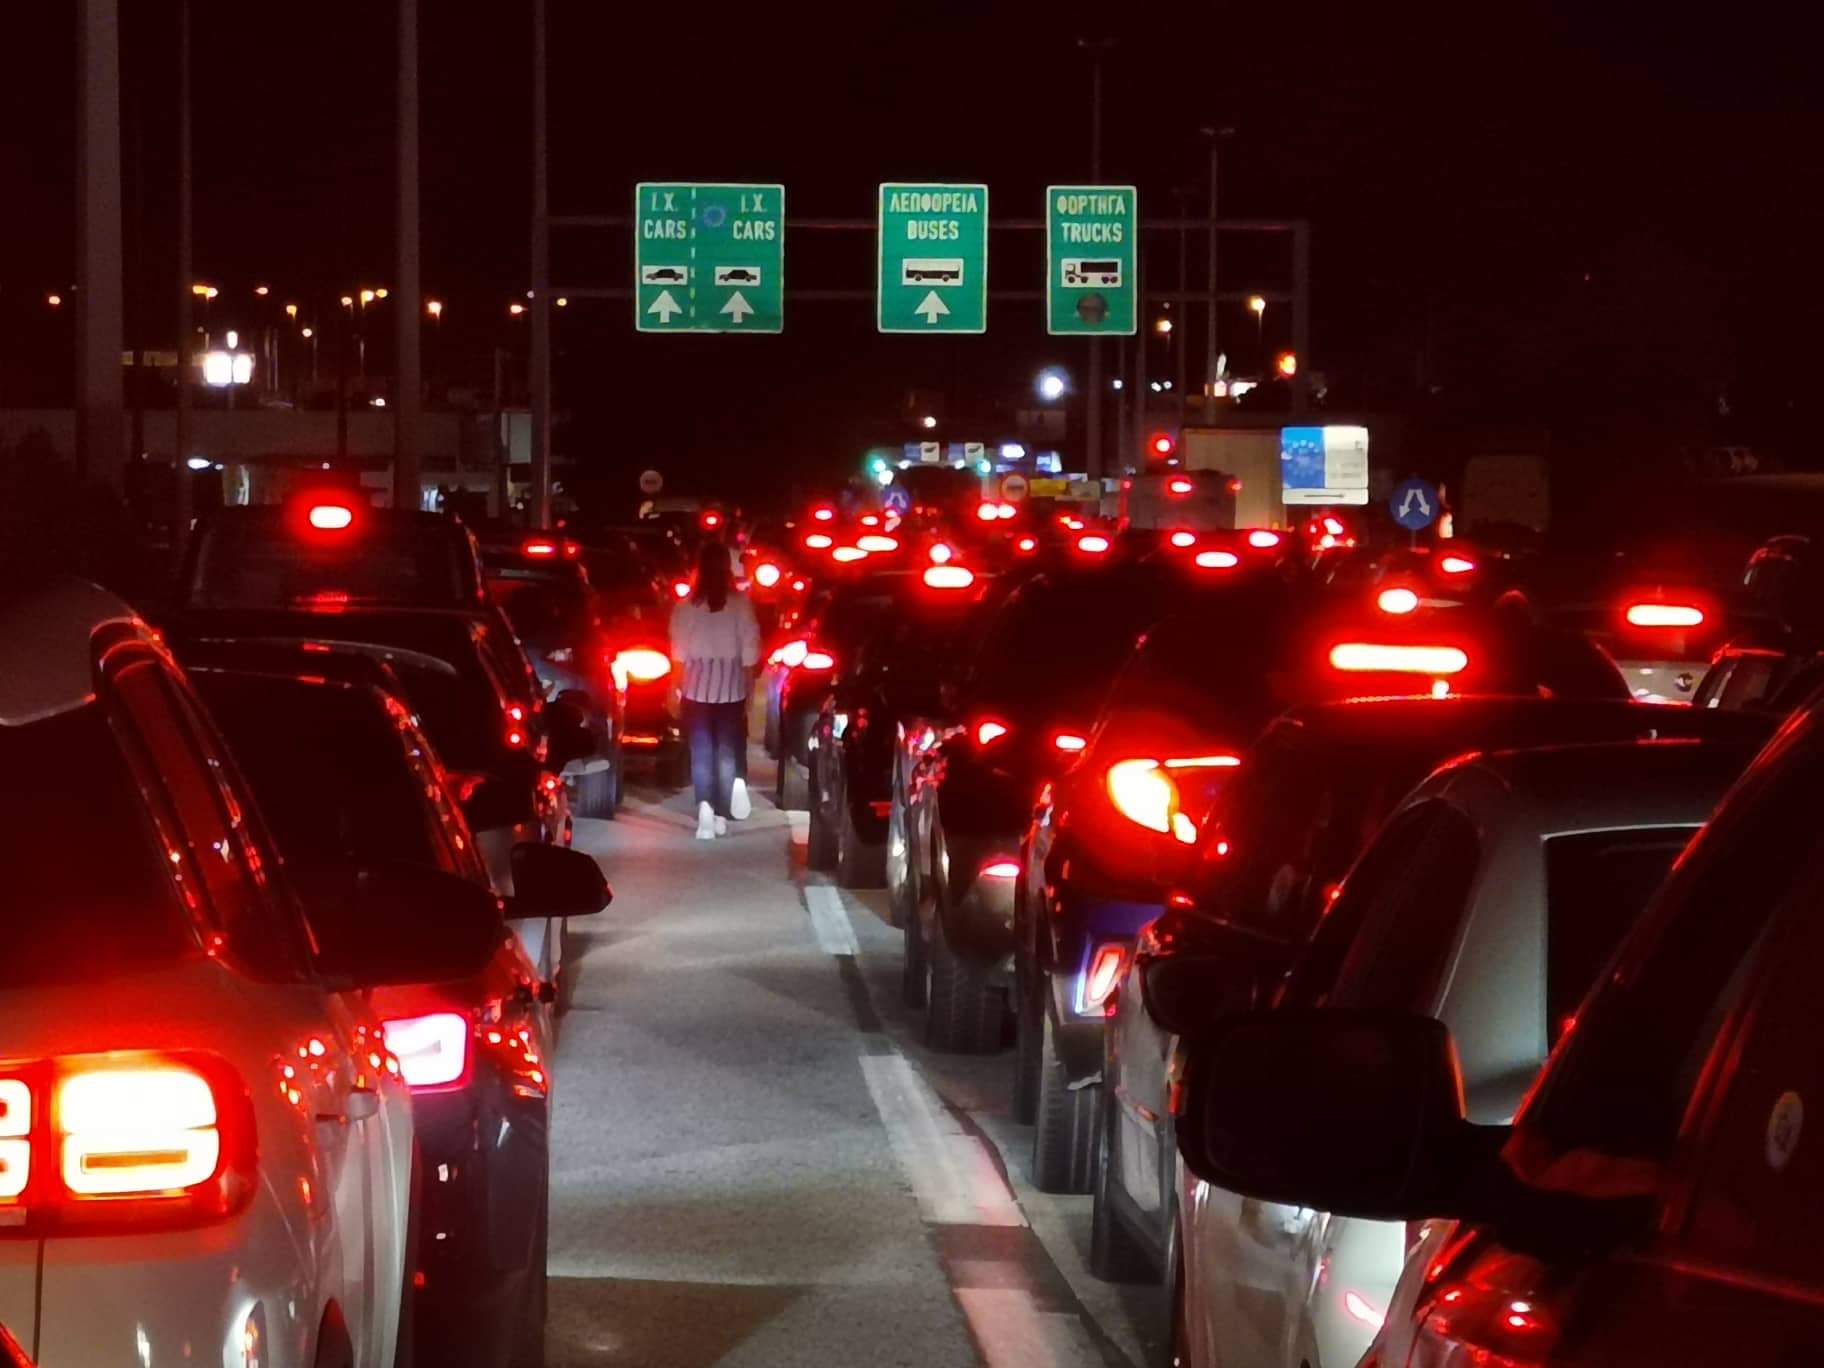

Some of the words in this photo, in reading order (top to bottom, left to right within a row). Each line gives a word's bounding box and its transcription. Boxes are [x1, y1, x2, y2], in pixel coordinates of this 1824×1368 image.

[1056, 195, 1126, 215] ΦΟΡΤΗΓΑ
[644, 219, 687, 239] CARS
[732, 220, 775, 240] CARS
[907, 219, 960, 240] BUSES
[1061, 222, 1123, 243] TRUCKS
